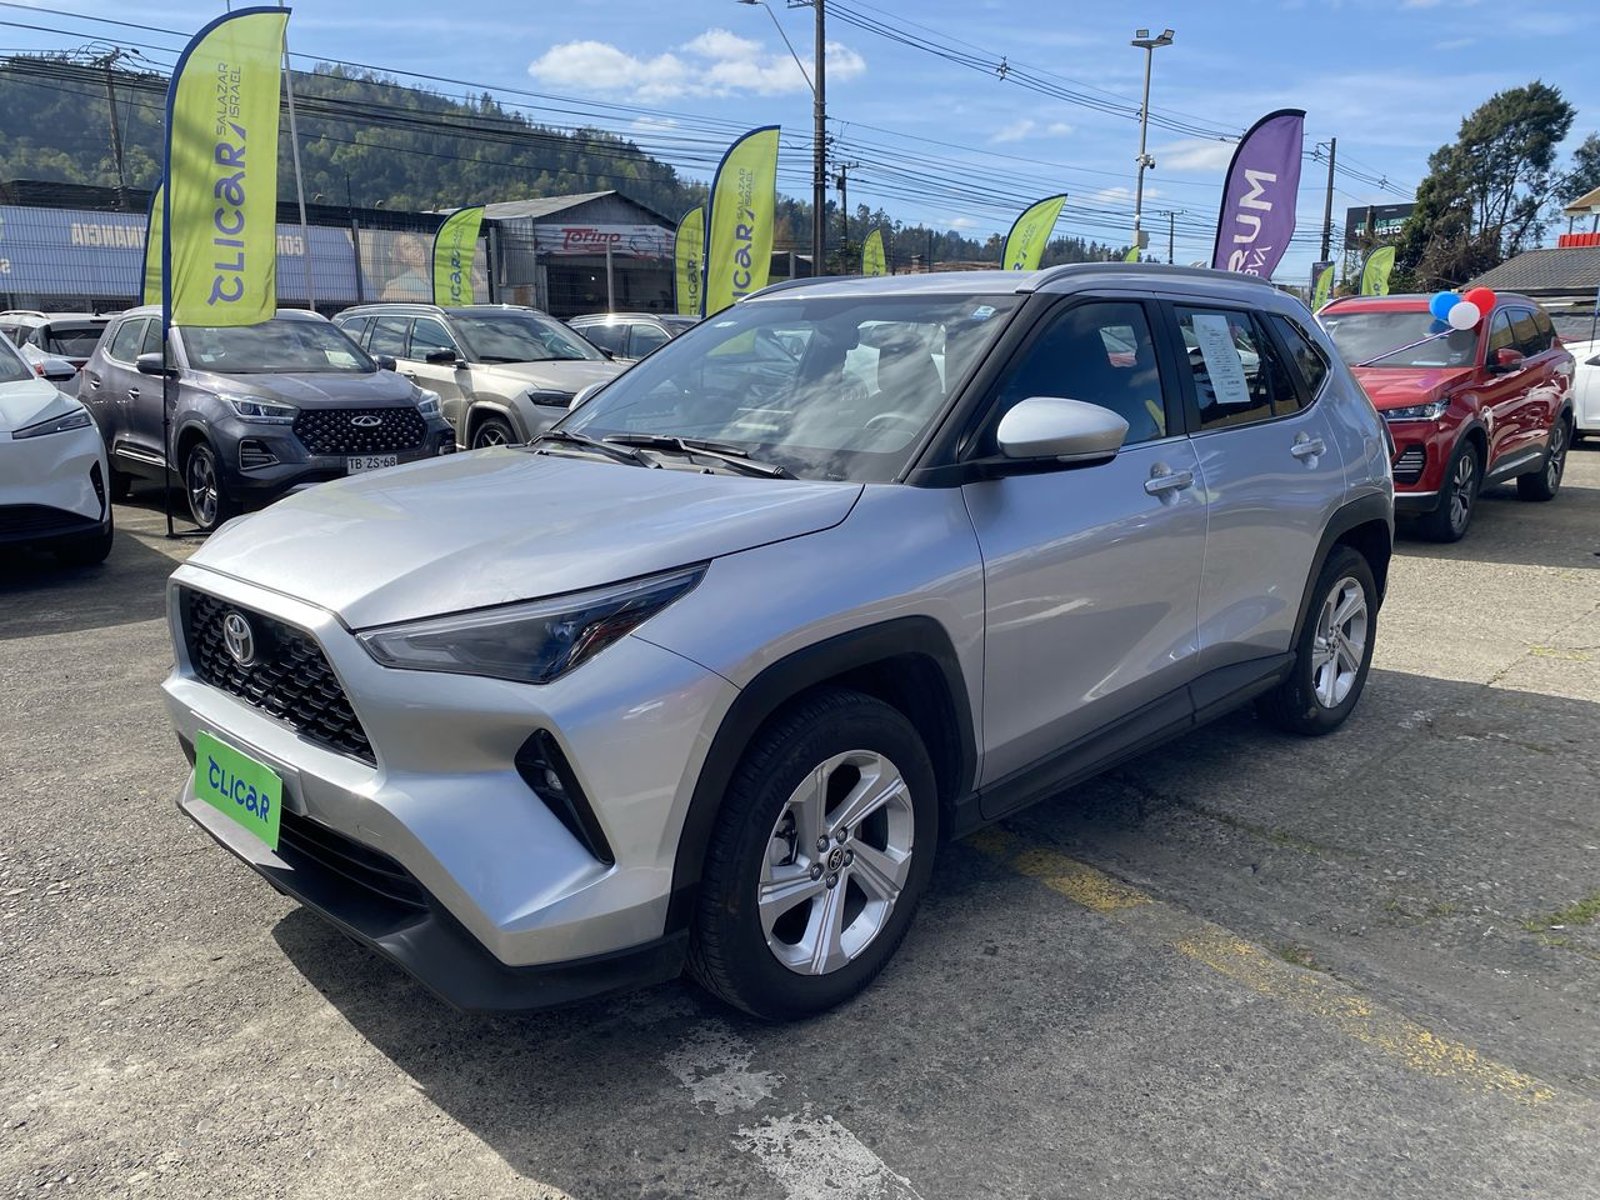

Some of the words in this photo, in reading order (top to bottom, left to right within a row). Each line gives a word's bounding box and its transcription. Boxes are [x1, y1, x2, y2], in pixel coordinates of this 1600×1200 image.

[216, 62, 229, 136] SALAZAR
[229, 66, 241, 119] ISRAEL
[736, 167, 747, 222] SALAZAR
[561, 227, 621, 250] Torino
